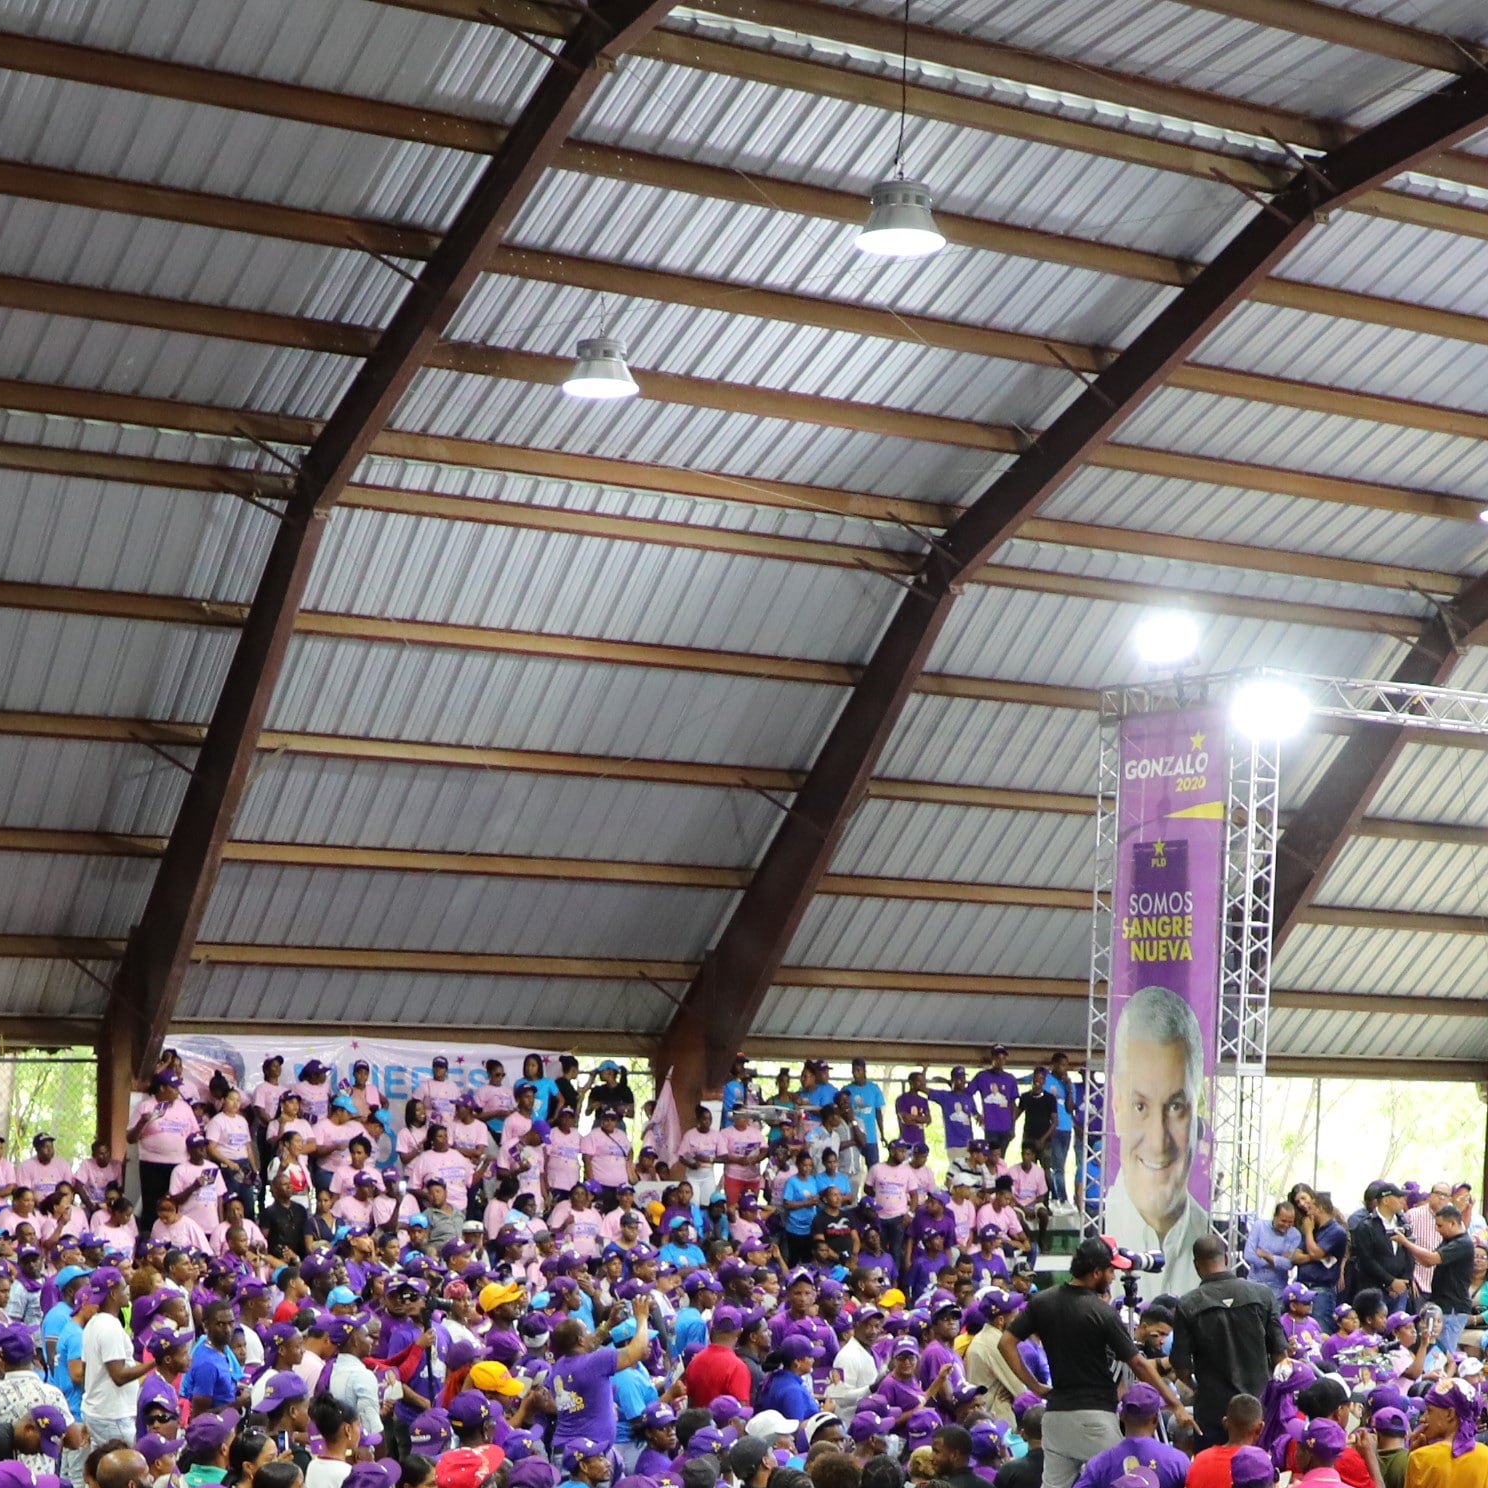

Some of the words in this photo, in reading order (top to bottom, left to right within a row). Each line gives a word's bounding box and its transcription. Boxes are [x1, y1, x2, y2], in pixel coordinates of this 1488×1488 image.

[1125, 752, 1209, 779] GONZALO
[1175, 776, 1206, 793] 2020
[1151, 858, 1167, 868] PLD
[1130, 892, 1193, 916] SOMOS
[1122, 915, 1193, 939] SANGRE
[1130, 939, 1194, 962] NUEVA
